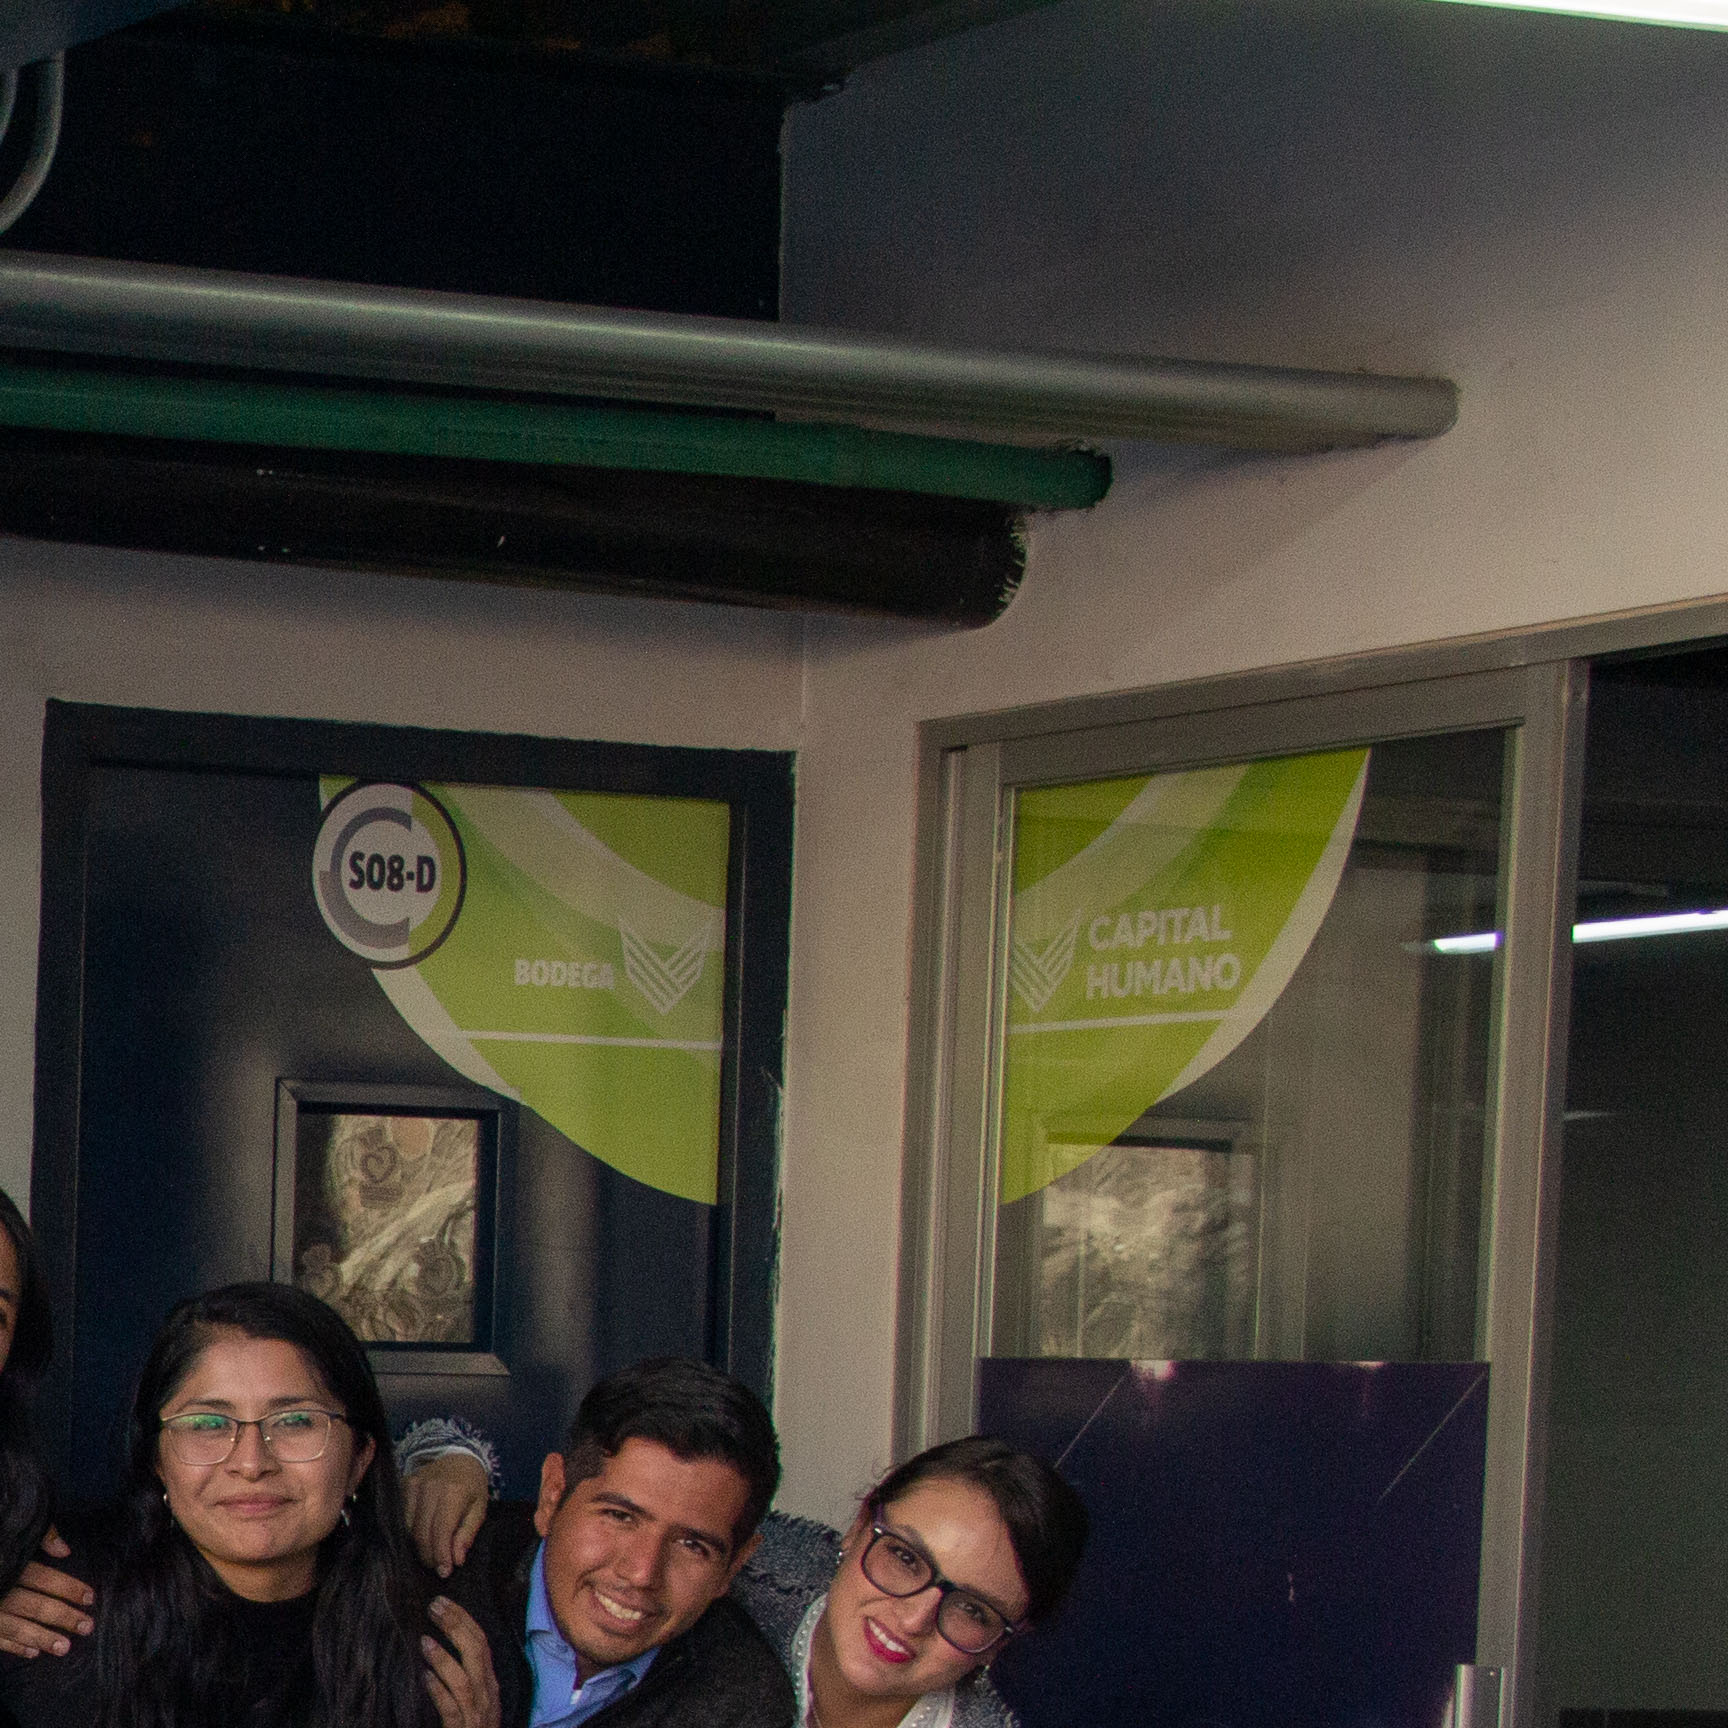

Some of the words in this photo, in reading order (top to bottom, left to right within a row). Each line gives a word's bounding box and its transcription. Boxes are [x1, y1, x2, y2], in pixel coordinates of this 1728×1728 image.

[1087, 904, 1233, 951] CAPITAL
[513, 958, 616, 990] BODEGA
[1085, 953, 1241, 1000] HUMANO
